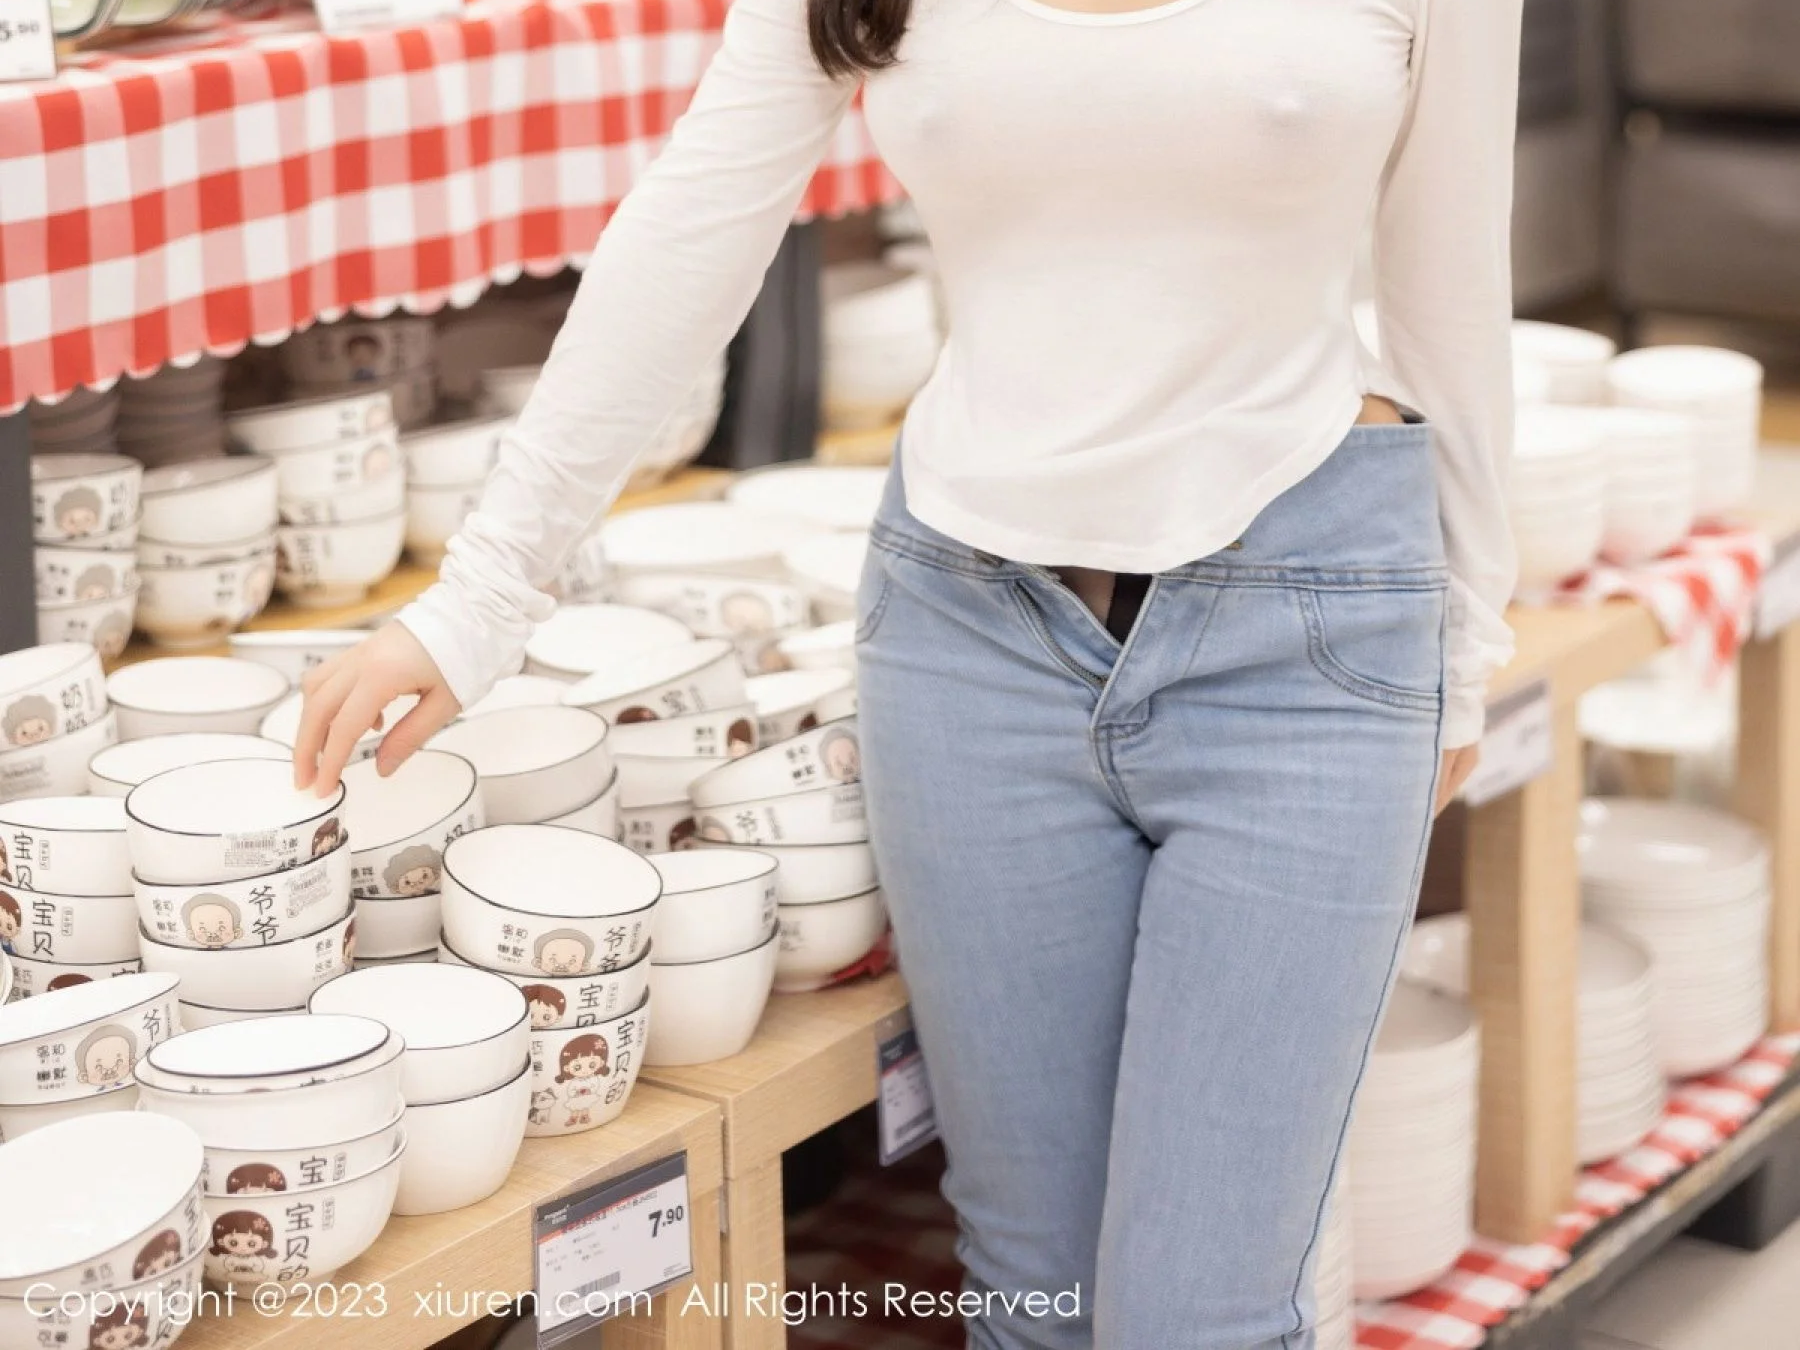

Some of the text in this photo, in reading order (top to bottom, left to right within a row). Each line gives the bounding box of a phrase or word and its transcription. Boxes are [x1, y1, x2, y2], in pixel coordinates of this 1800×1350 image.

[14, 830, 34, 891] 宝贝
[32, 899, 56, 956] 宝贝
[249, 885, 280, 945] 爷爷
[605, 1019, 635, 1105] 宝贝的
[277, 1202, 315, 1282] 宝贝的
[648, 1205, 684, 1238] 7.90
